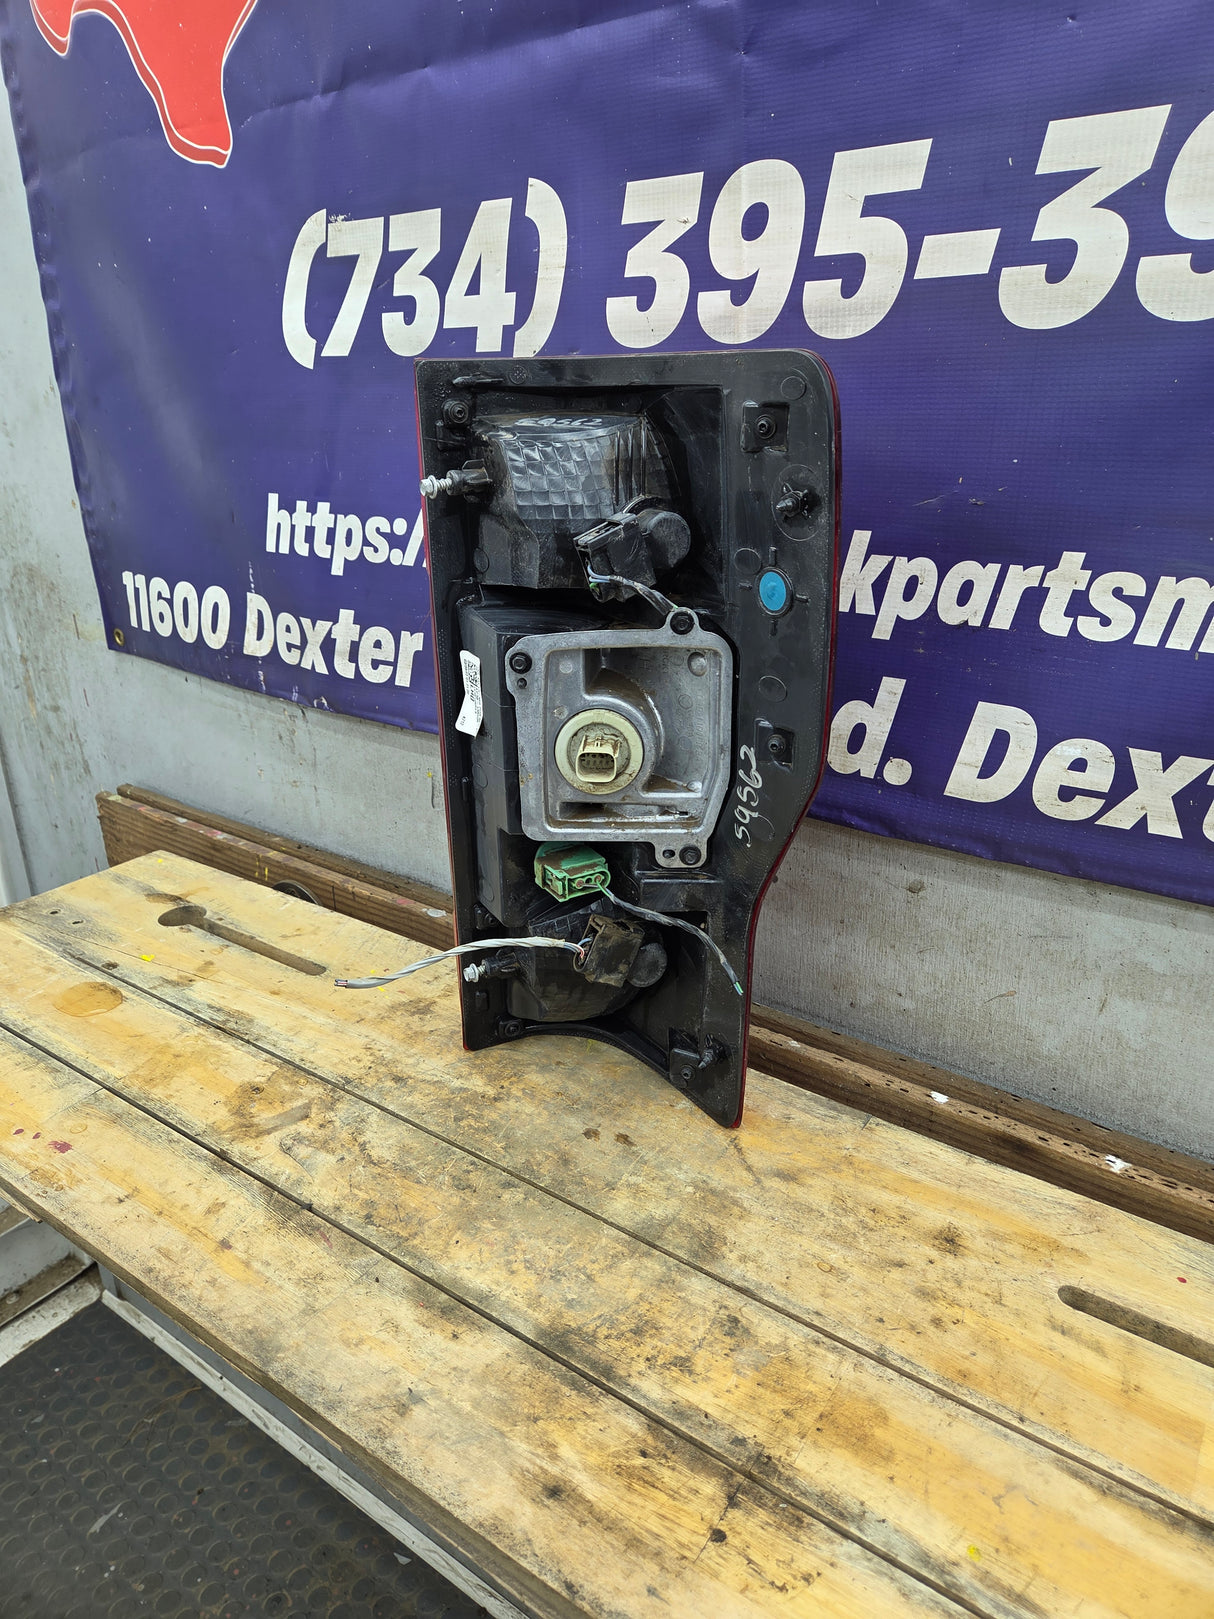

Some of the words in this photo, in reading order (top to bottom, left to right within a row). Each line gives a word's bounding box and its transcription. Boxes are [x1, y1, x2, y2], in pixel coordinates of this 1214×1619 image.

[282, 178, 567, 369] (734)
[606, 104, 1214, 348] 395-39
[266, 493, 427, 576] https:/
[122, 571, 231, 650] 11600
[243, 591, 424, 687] Dexter
